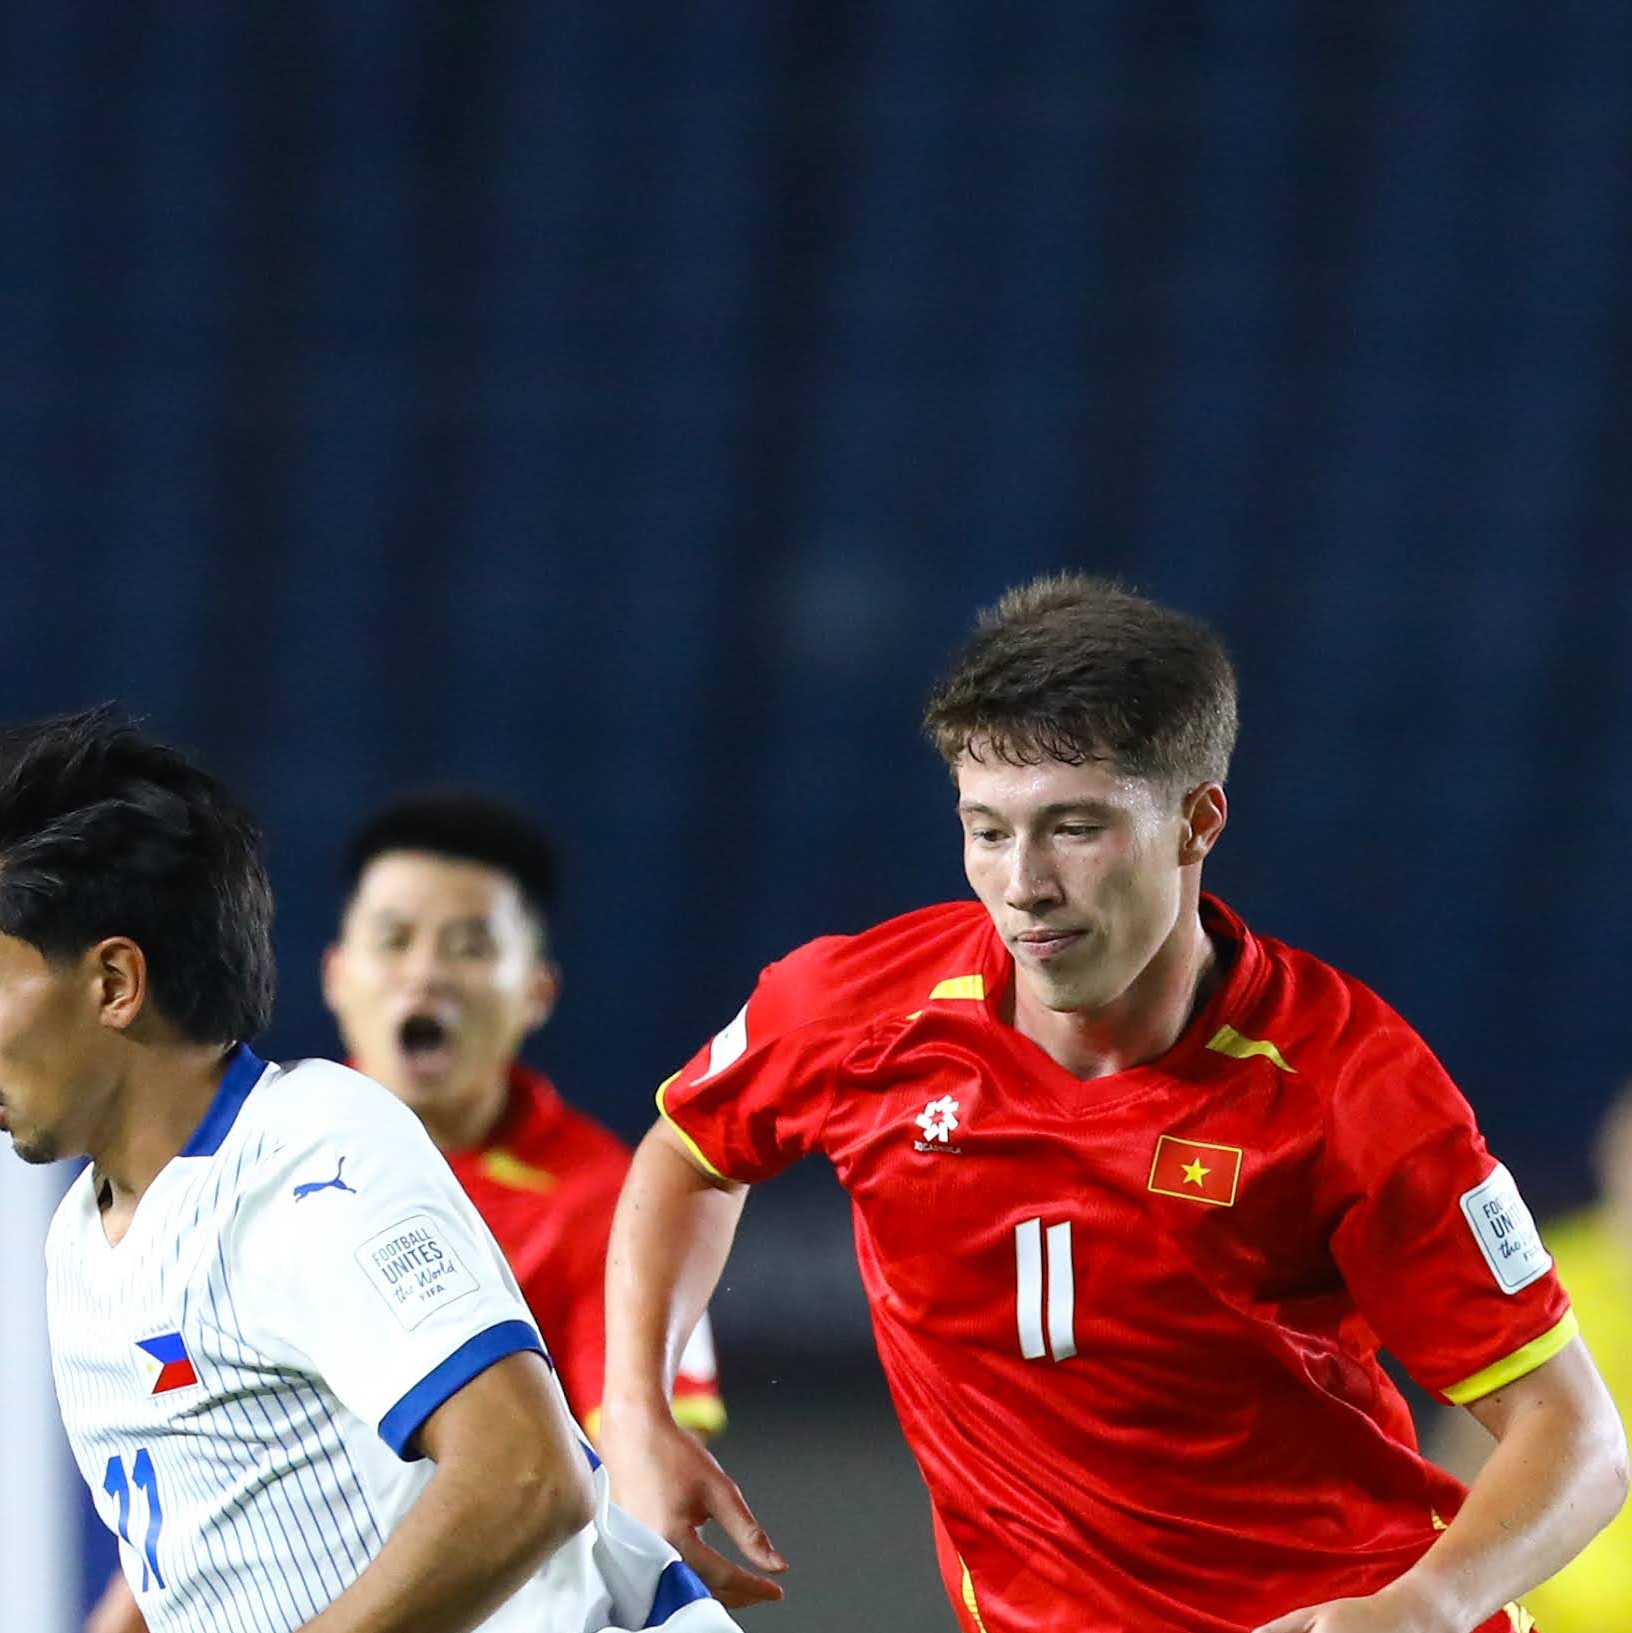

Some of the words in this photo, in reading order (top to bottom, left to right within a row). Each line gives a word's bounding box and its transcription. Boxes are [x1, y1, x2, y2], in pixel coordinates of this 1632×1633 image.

[371, 1227, 433, 1268] FOOTBALL
[381, 1240, 444, 1285] UNITES
[413, 1258, 458, 1289] World
[419, 1283, 446, 1302] FIFA
[1015, 1217, 1078, 1363] 11
[103, 1447, 166, 1593] 11
